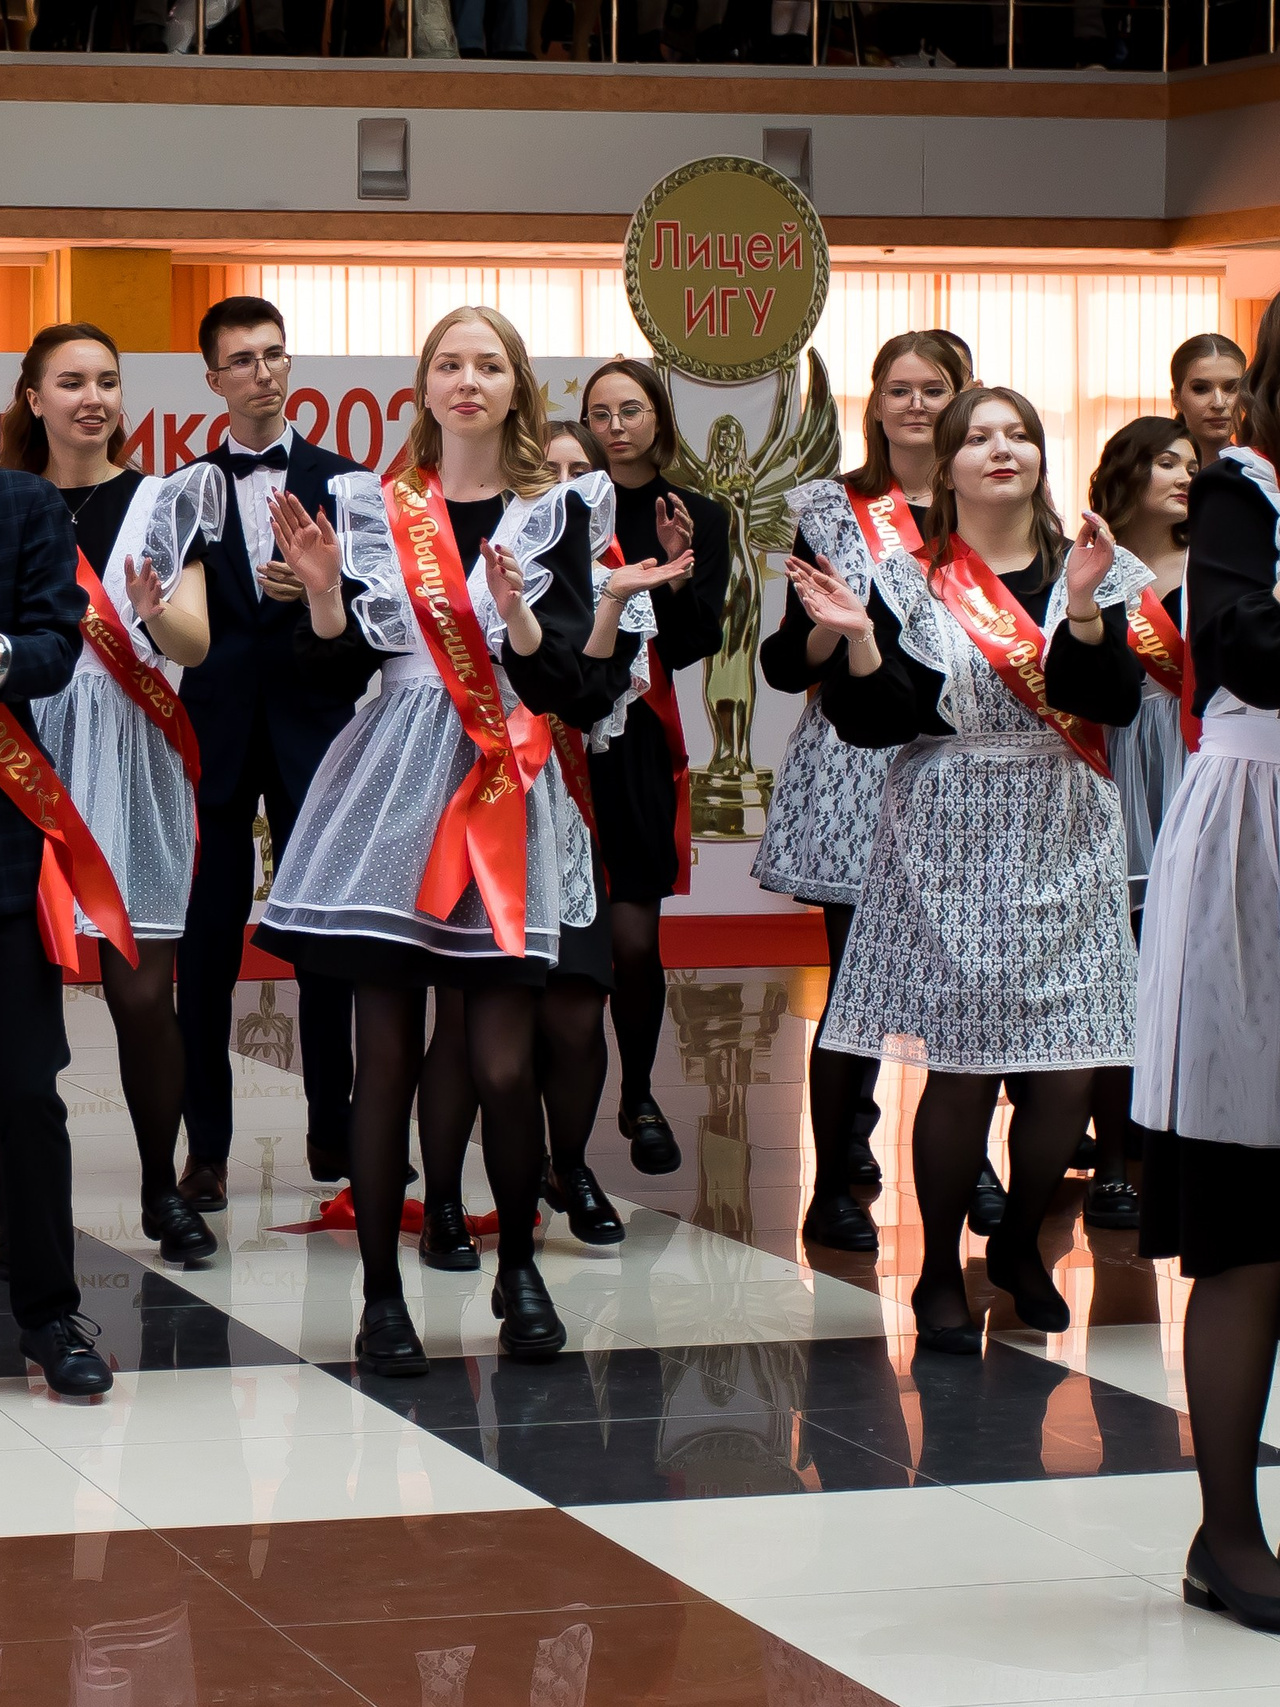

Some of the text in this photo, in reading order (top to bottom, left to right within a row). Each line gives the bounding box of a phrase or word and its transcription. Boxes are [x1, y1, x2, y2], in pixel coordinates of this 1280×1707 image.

[649, 220, 803, 278] Лицей
[685, 285, 777, 339] ИГУ
[284, 387, 417, 474] 202
[408, 516, 477, 683] Выпускник
